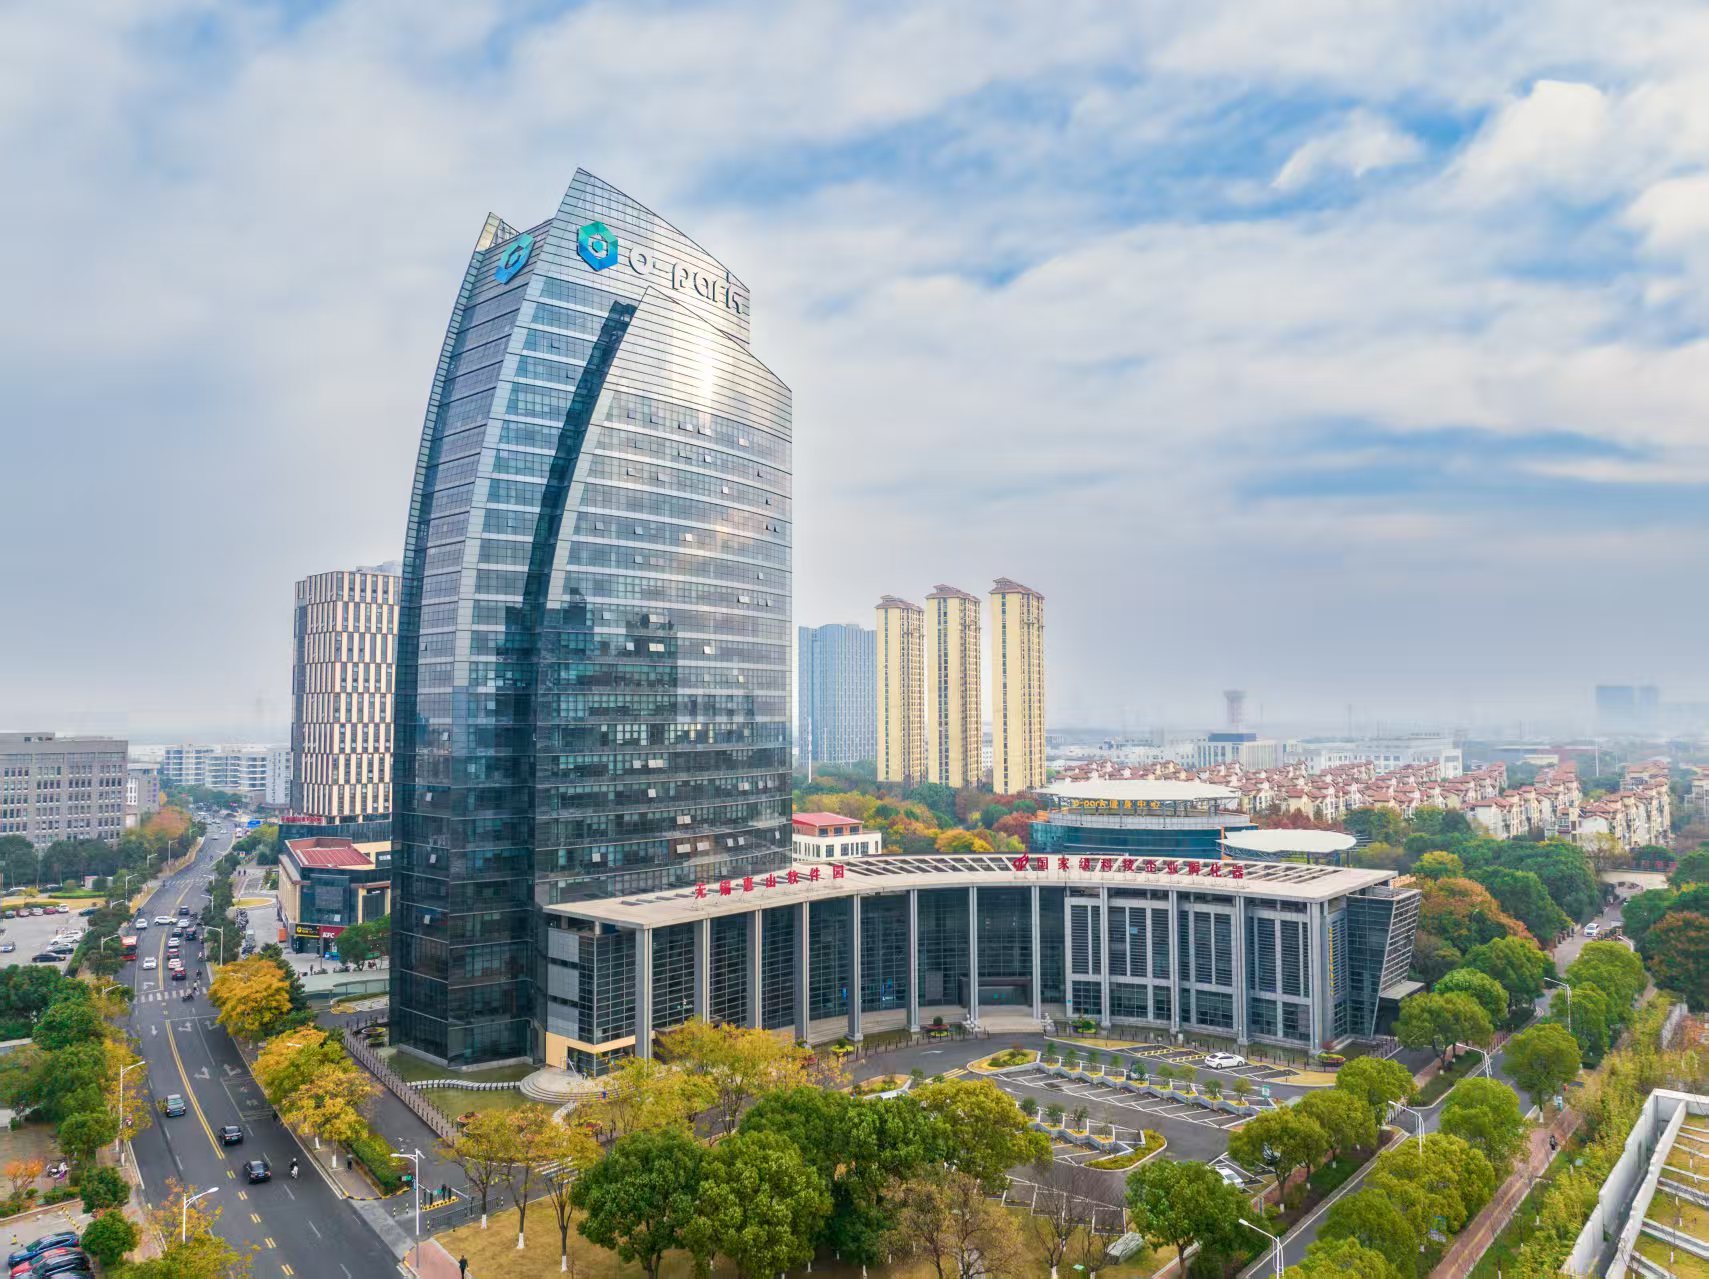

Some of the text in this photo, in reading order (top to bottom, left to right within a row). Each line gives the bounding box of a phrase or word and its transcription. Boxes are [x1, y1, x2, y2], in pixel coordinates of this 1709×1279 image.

[694, 864, 845, 899] 无锡惠山软件园
[1037, 855, 1244, 879] 国家级科技企业孵化器
